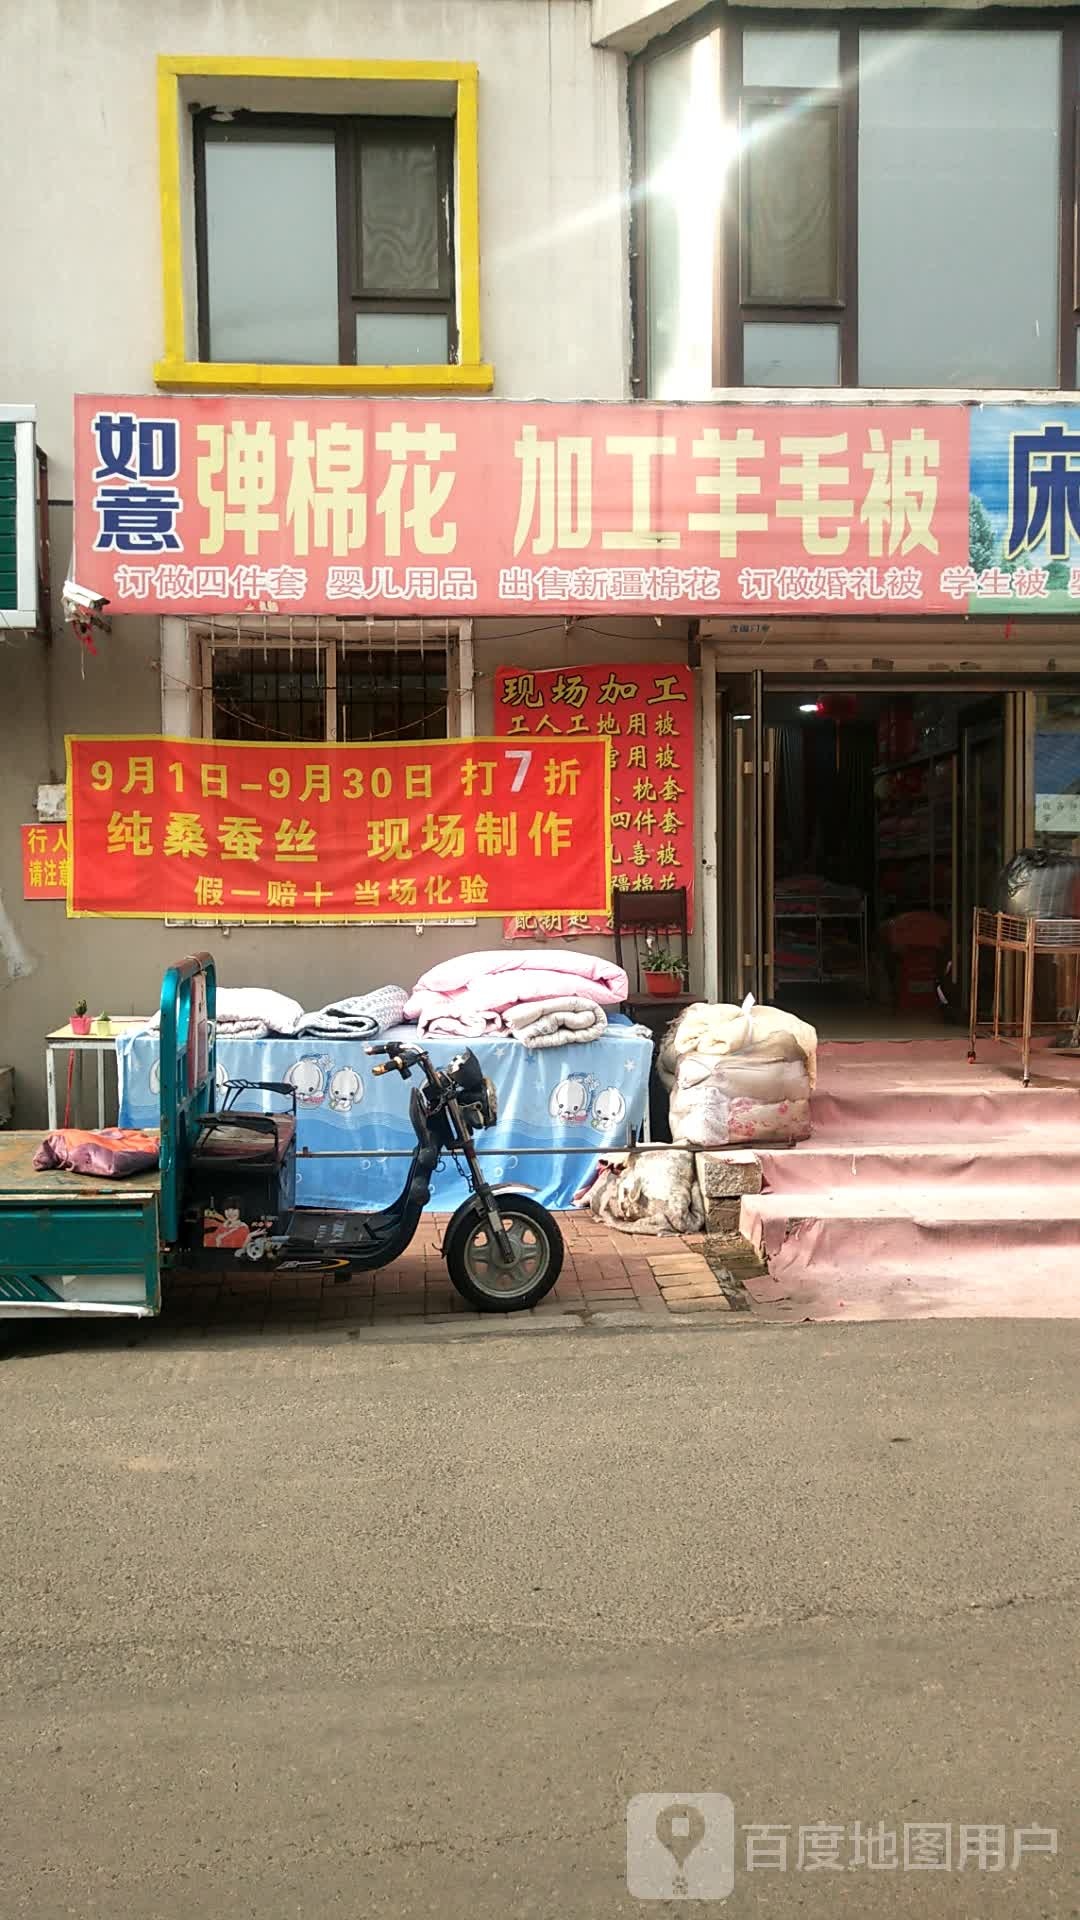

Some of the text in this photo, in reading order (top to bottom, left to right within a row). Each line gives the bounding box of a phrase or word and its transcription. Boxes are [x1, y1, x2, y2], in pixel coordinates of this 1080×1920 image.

[92, 411, 184, 554] 如意
[197, 420, 940, 558] 弹棉花 加工羊毛被
[115, 564, 308, 601] 订做四件套
[327, 565, 478, 601] 婴儿用品
[499, 567, 720, 601] 出售新疆棉花
[739, 567, 922, 600] 订做婚礼被
[940, 566, 1051, 600] 学生被
[501, 673, 688, 708] 现场加工
[506, 711, 681, 736] 工人工地用被
[90, 749, 582, 801] 9月1日-9月30日 打7折
[106, 811, 574, 864] 纯桑蚕丝 现场制作
[611, 808, 684, 835] 四件套
[28, 828, 68, 853] 行人
[194, 875, 489, 909] 假一赔十 当场化验
